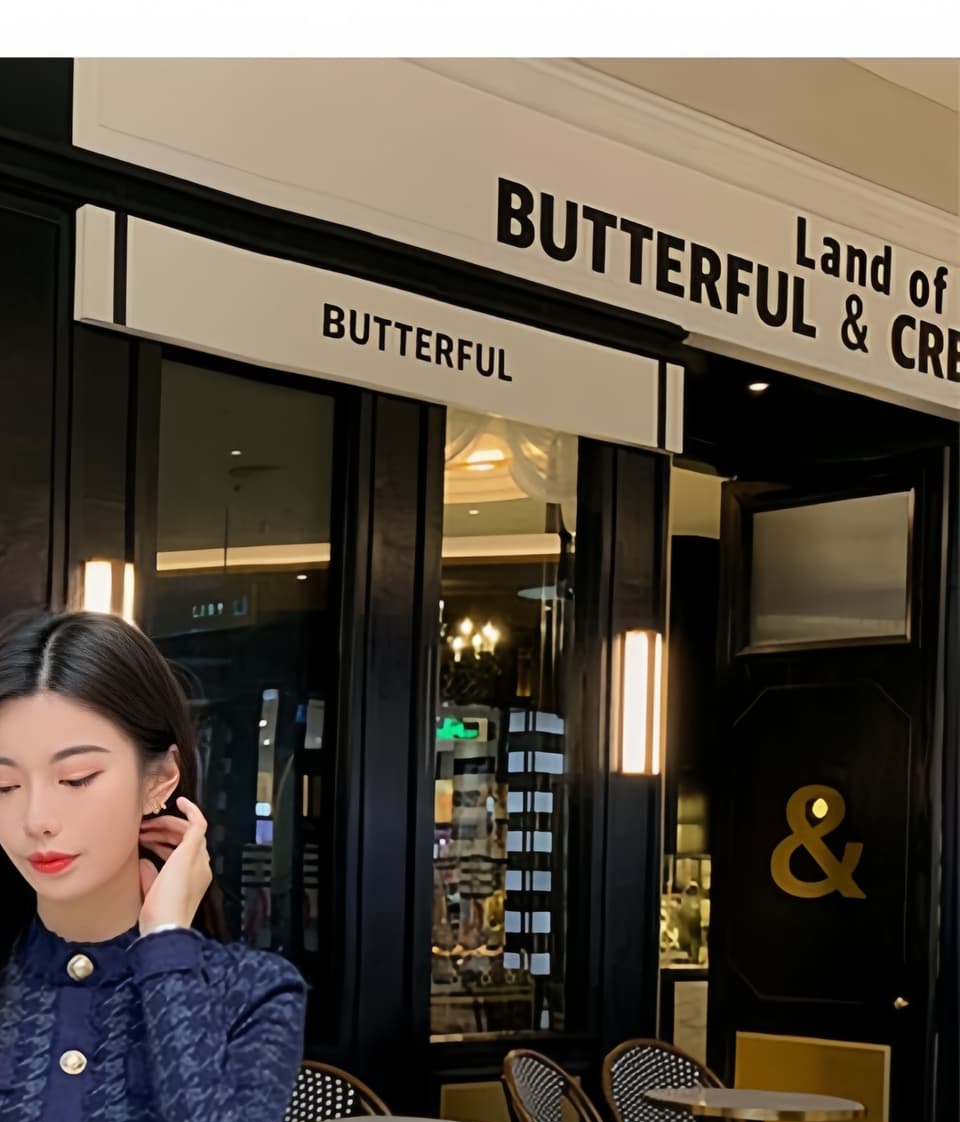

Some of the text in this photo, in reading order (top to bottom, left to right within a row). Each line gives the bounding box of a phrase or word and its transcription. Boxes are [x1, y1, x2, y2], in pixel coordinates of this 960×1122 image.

[495, 176, 818, 340] BUTTERFUL
[840, 293, 870, 354] &
[795, 215, 949, 315] Land of
[321, 302, 514, 383] BUTTERFUL
[770, 783, 867, 899] &
